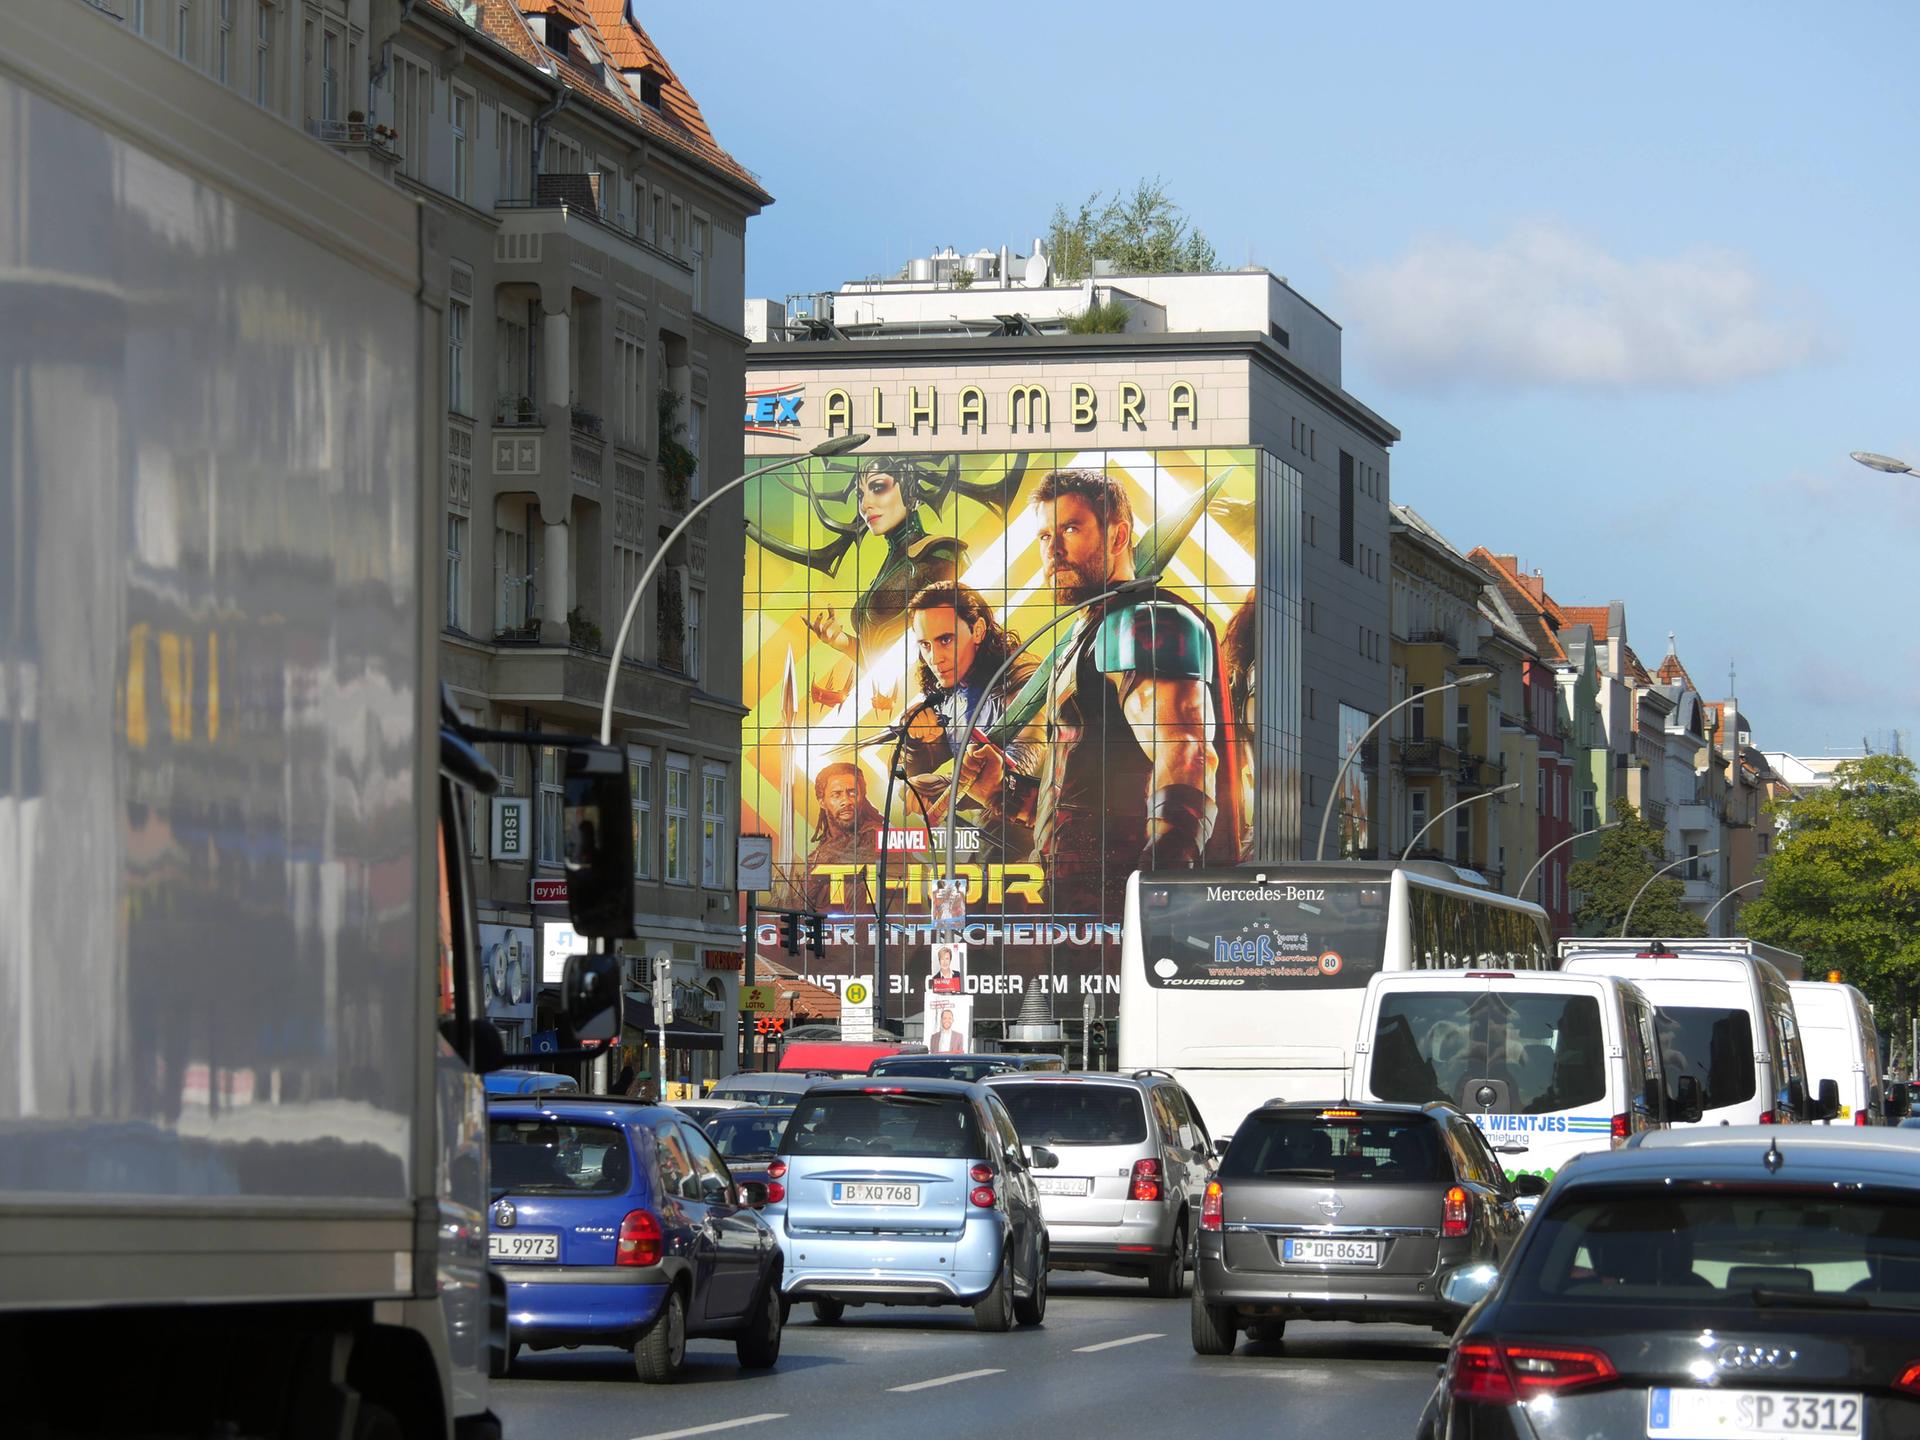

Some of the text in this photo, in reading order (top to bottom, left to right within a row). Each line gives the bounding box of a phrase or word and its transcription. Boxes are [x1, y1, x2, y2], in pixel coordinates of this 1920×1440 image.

[824, 380, 1198, 430] ALHAMBRA
[504, 808, 518, 850] BASE
[811, 863, 1044, 905] THOR
[1207, 886, 1325, 901] Mercedes-Benz
[1214, 934, 1275, 966] heeß
[1324, 958, 1336, 968] 80
[1038, 974, 1068, 994] IM
[1490, 1115, 1566, 1132] WIENTJES
[846, 1186, 856, 1199] B
[886, 1187, 912, 1201] 768
[513, 1238, 555, 1255] 9973
[1294, 1242, 1304, 1257] B
[1337, 1243, 1374, 1259] 8631
[1783, 1396, 1858, 1431] 3312
